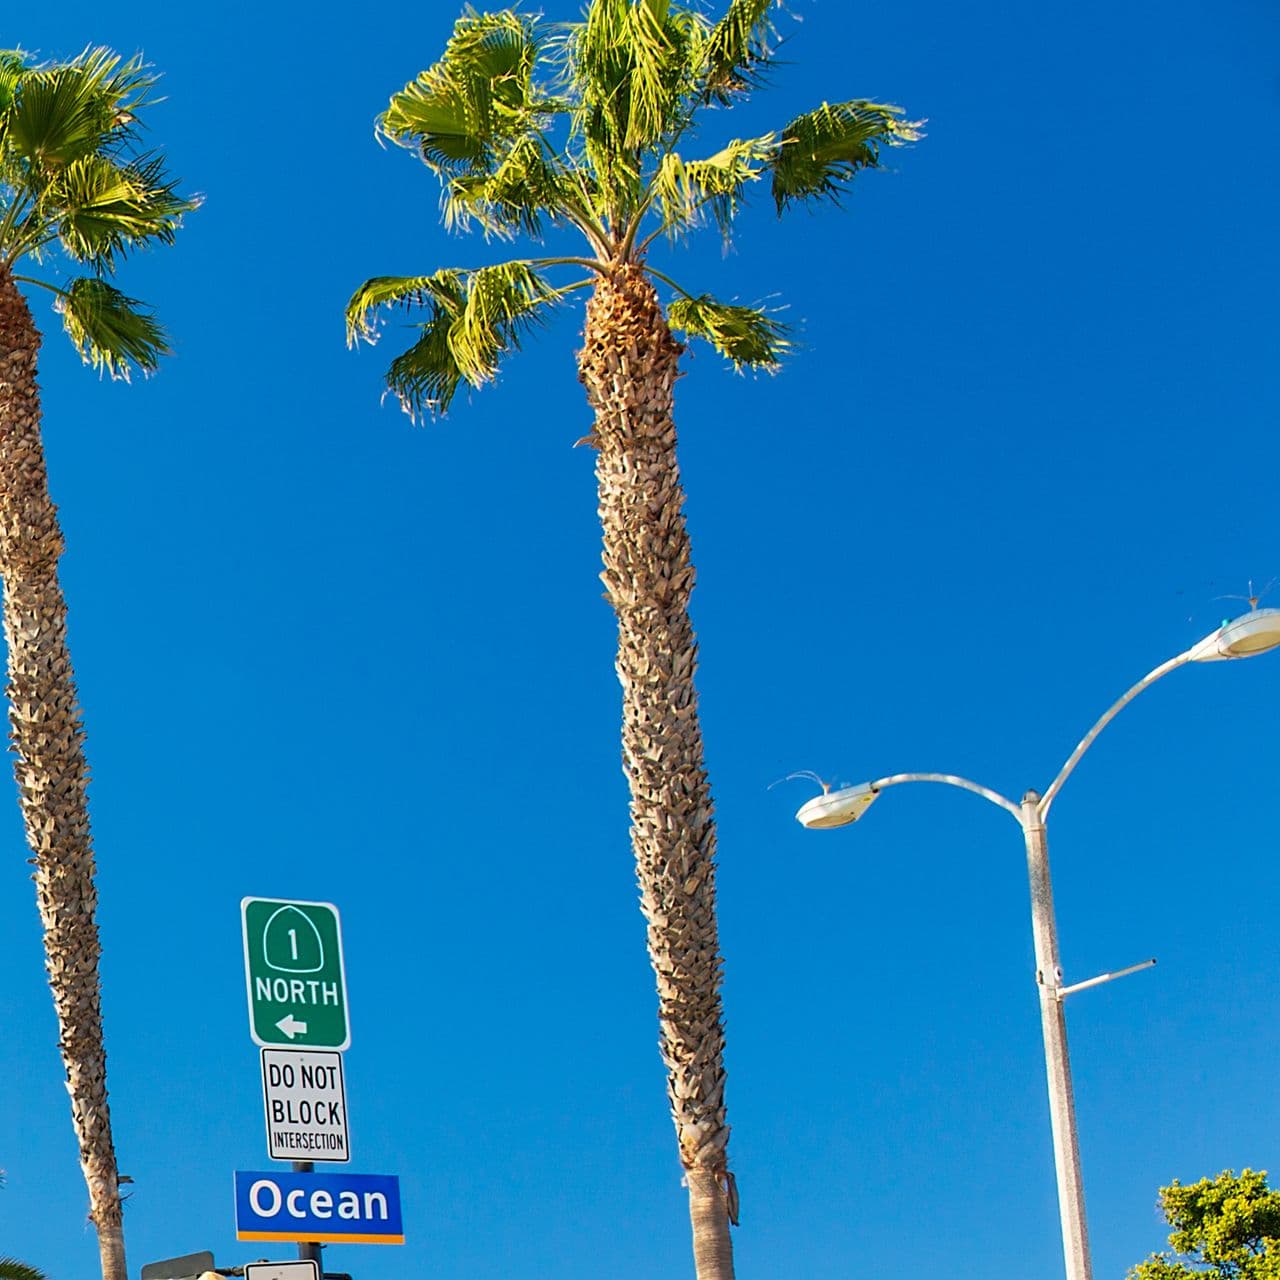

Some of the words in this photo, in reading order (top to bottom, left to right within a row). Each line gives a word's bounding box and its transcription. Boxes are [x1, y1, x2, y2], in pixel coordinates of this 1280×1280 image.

[287, 928, 298, 960] 1
[255, 976, 339, 1006] NORTH
[269, 1063, 295, 1089] DO
[302, 1065, 338, 1090] NOT
[272, 1099, 341, 1126] BLOCK
[273, 1131, 344, 1151] INTERSECTION
[248, 1179, 389, 1220] Ocean
